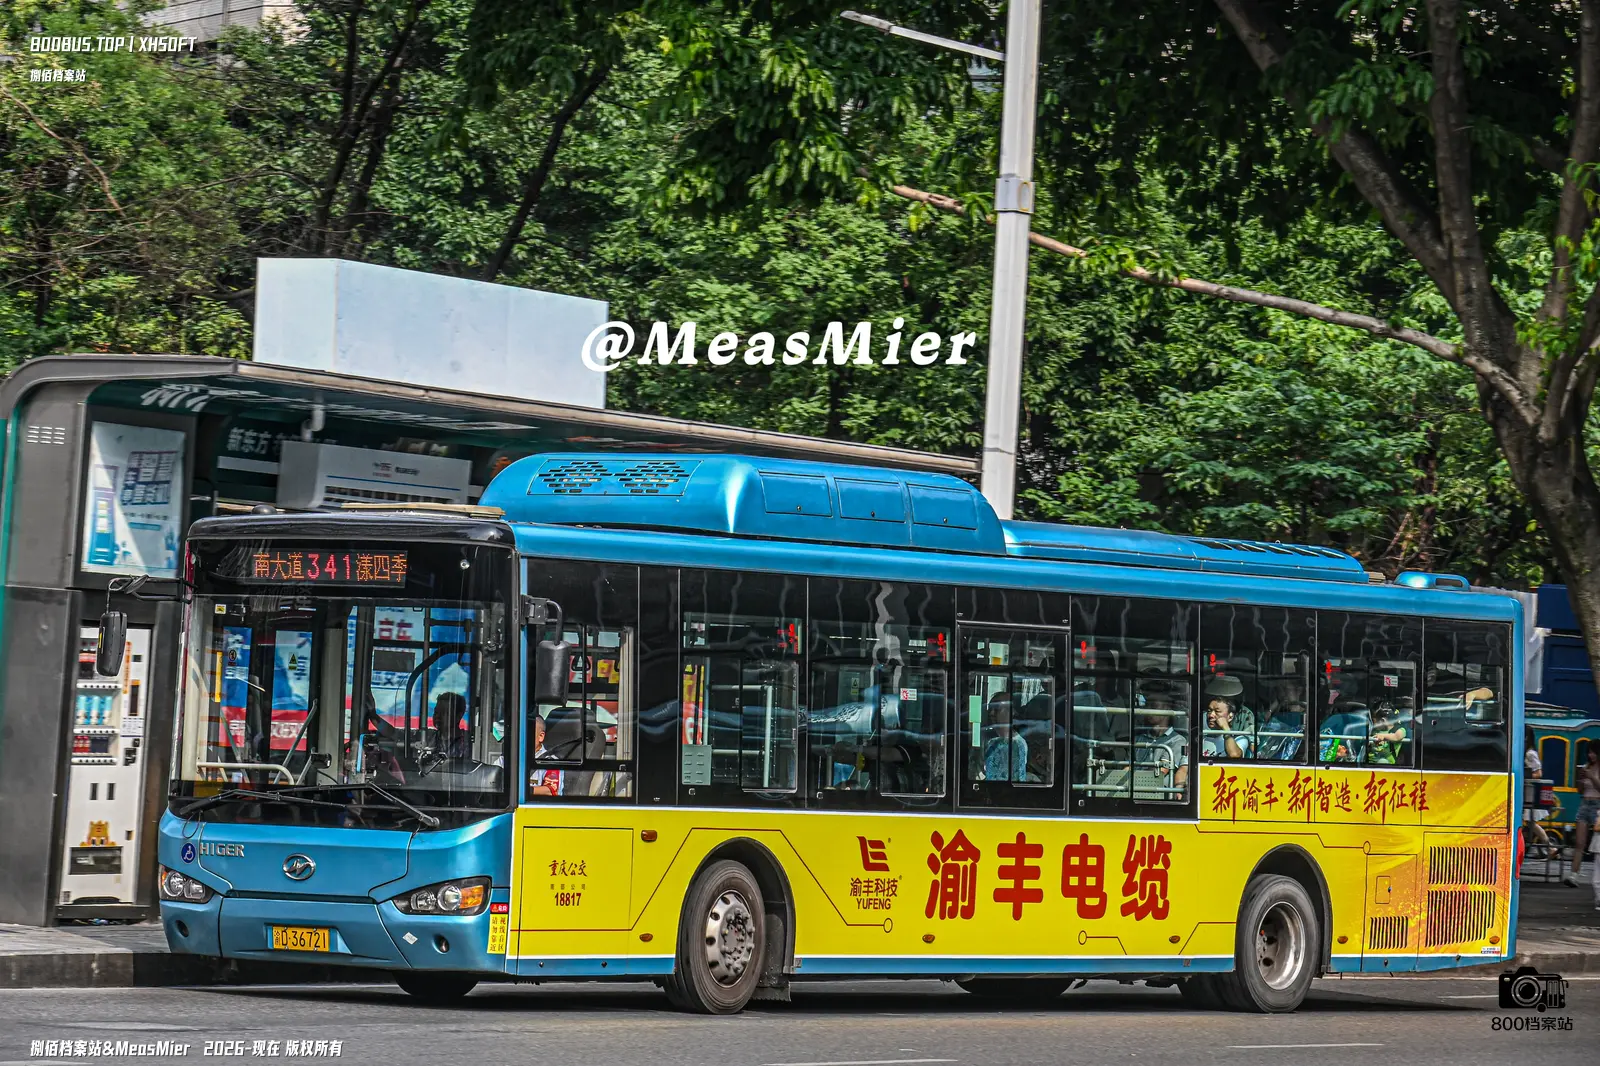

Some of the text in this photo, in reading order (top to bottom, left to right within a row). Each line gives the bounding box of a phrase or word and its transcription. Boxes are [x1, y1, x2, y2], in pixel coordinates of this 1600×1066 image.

[253, 551, 408, 582] 南大道 341 漾四季
[199, 842, 245, 858] HIGER
[548, 859, 588, 878] 重庆公交
[925, 829, 1173, 922] 渝丰电缆
[849, 877, 899, 898] 渝丰科技
[554, 892, 582, 907] 18817
[856, 897, 892, 911] YUFENG
